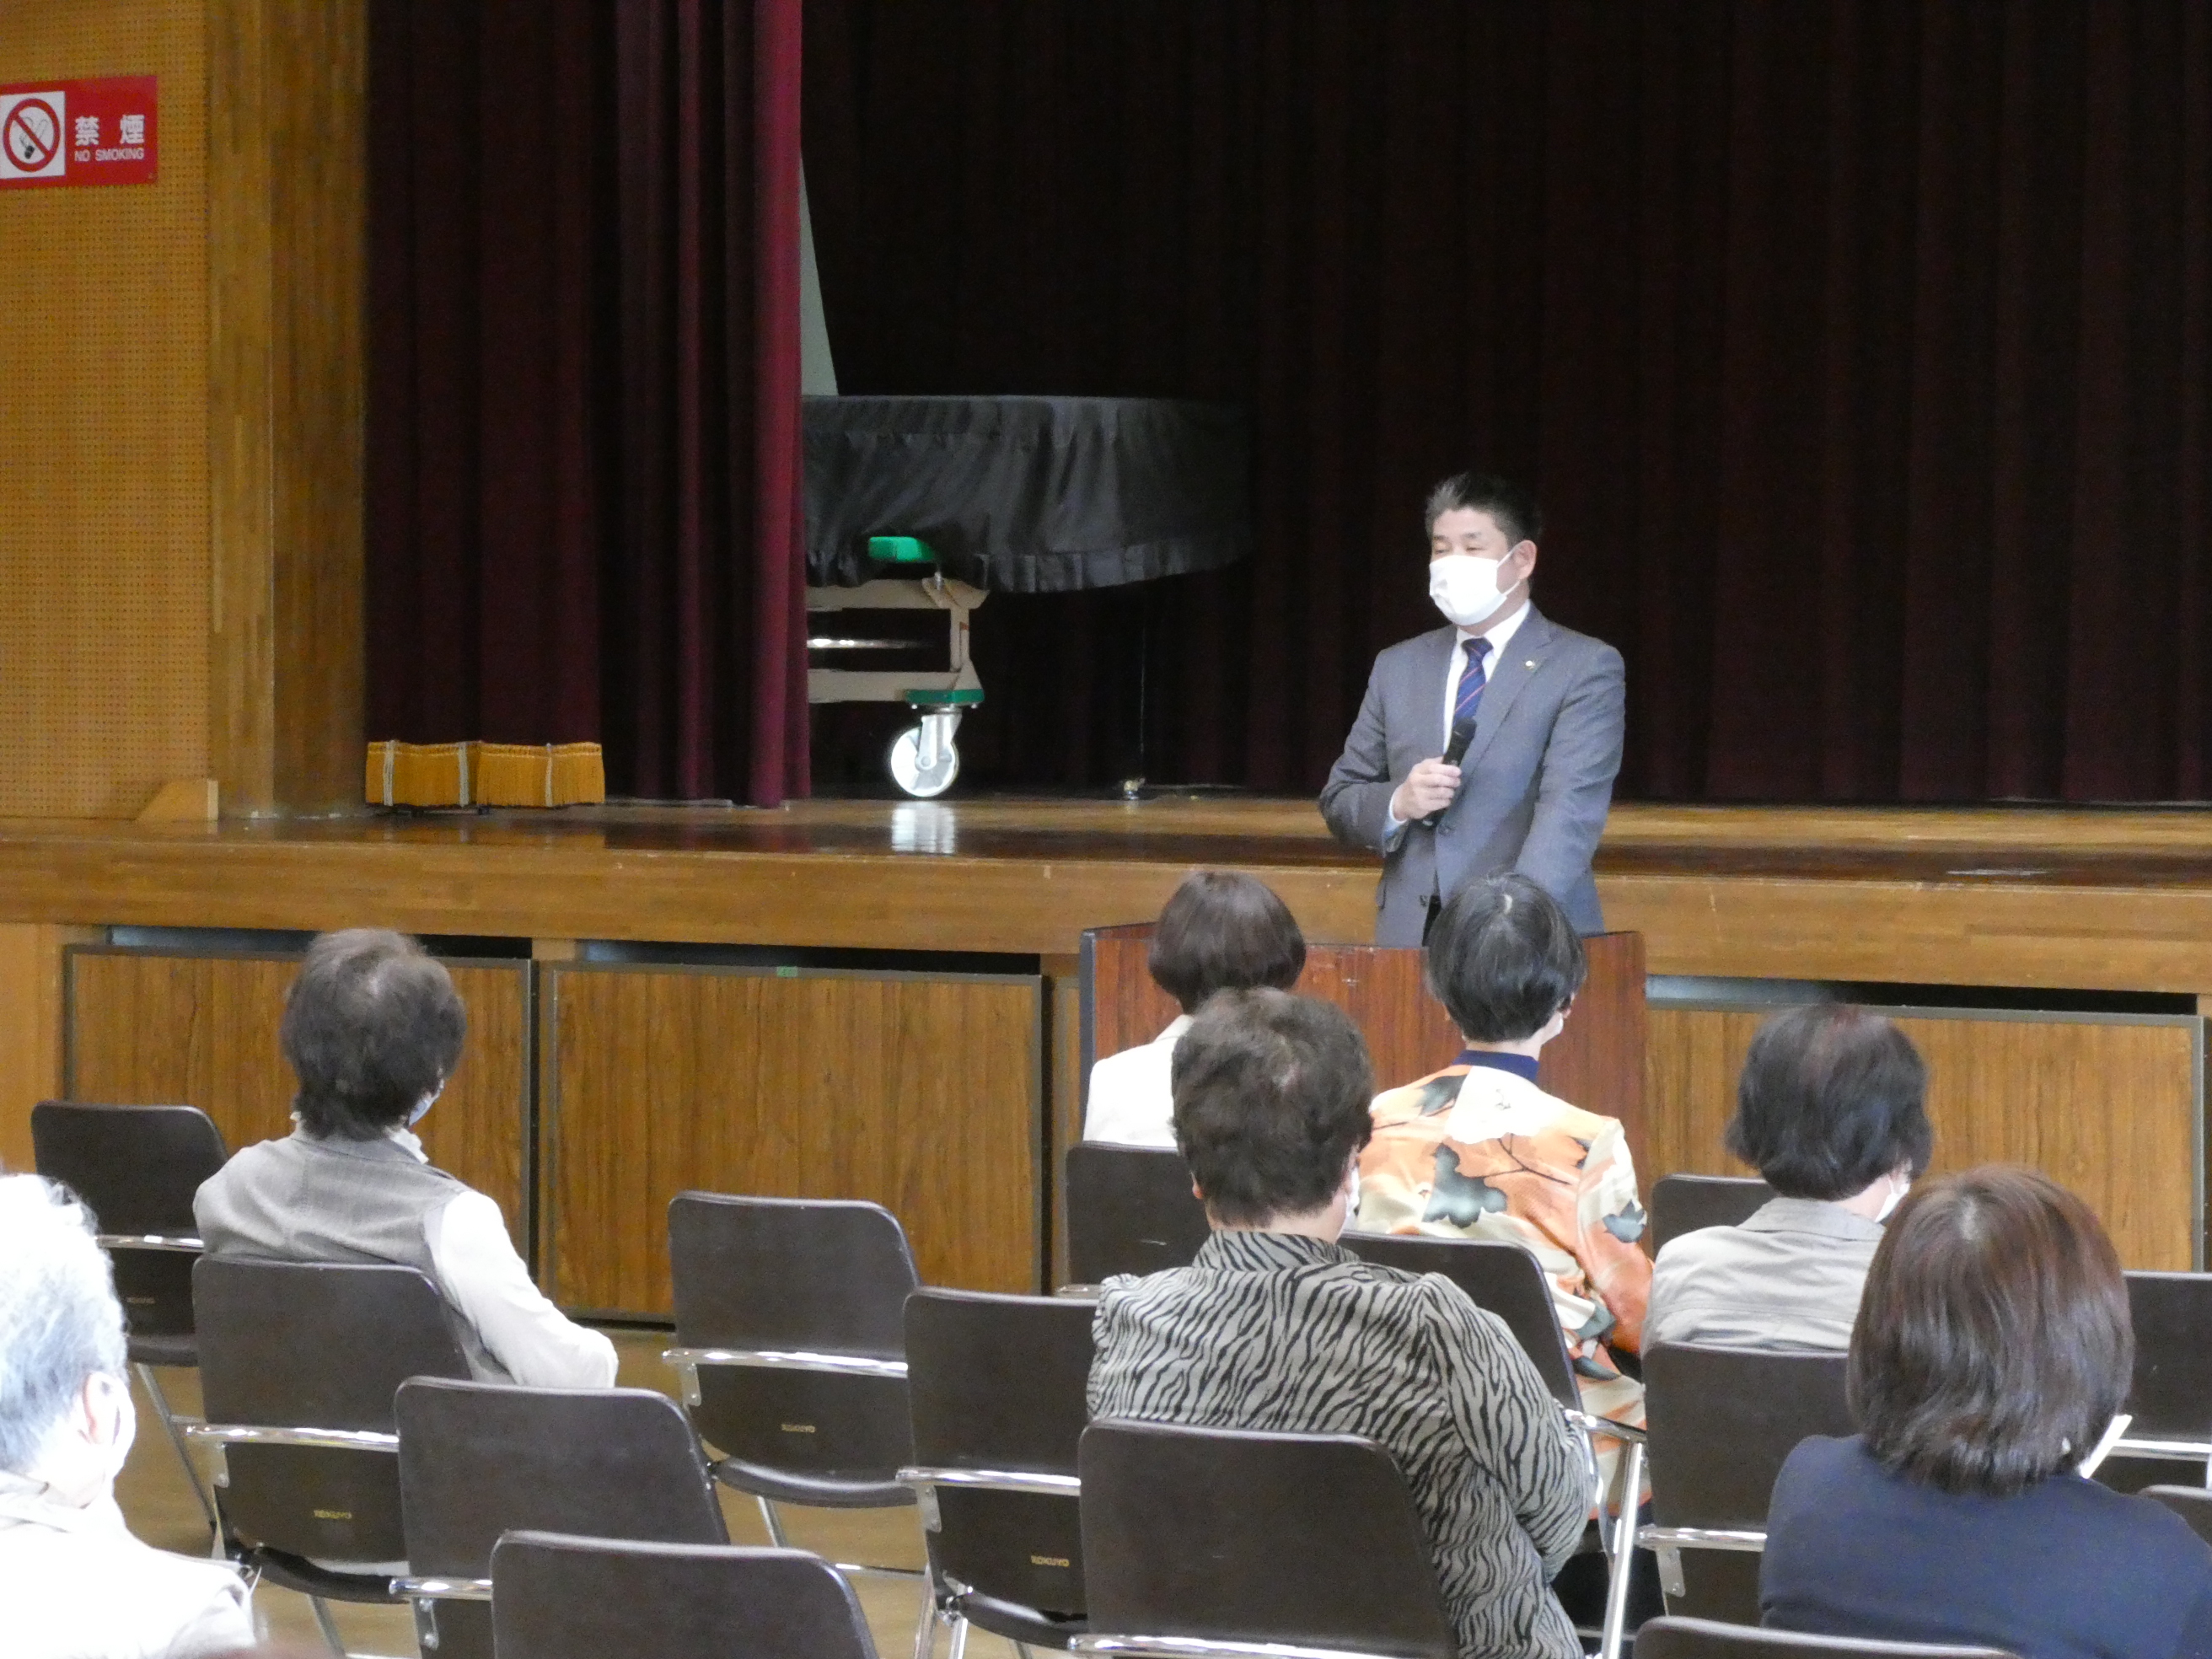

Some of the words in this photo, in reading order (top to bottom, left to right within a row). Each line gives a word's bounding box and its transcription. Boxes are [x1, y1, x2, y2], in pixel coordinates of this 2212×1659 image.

[75, 115, 144, 146] 禁煙
[74, 149, 90, 161] NO
[95, 148, 144, 161] SMOKING
